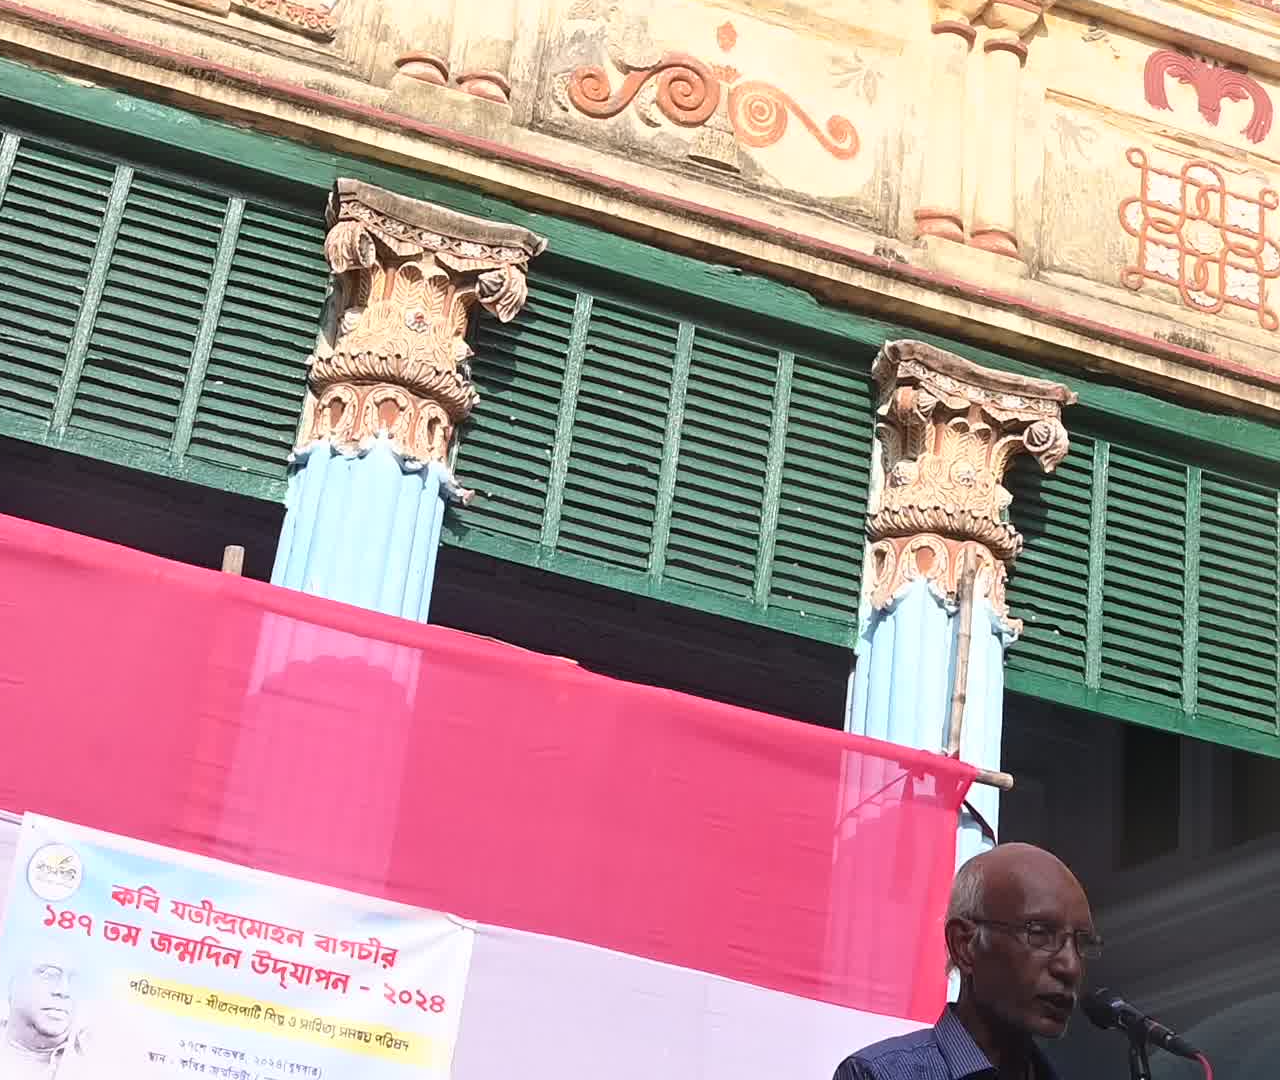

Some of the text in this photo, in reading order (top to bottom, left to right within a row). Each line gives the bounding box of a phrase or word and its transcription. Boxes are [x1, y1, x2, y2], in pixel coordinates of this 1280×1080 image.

[43, 904, 94, 936] ১৪৭
[103, 920, 142, 946] তম
[150, 930, 243, 969] জন্মদিন
[383, 981, 446, 1013] ২০২৪
[111, 884, 399, 969] কবি যতীন্দ্রমোহন বাগচীর
[288, 1016, 297, 1028] ও
